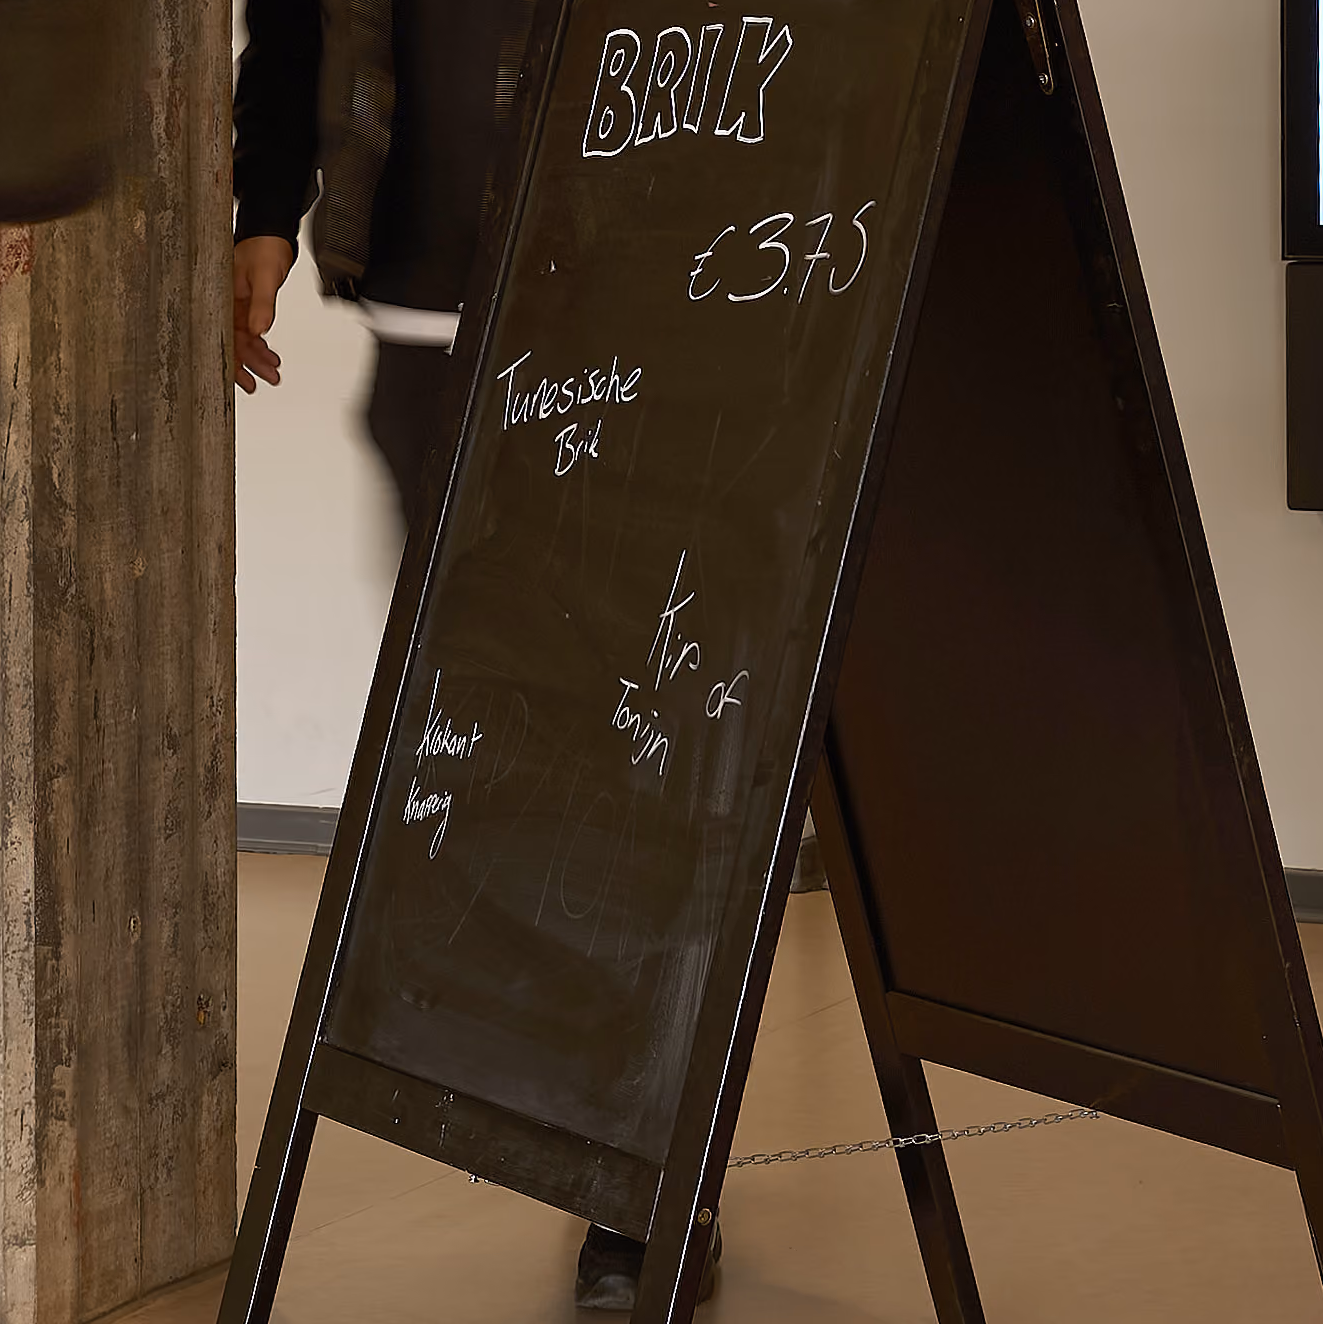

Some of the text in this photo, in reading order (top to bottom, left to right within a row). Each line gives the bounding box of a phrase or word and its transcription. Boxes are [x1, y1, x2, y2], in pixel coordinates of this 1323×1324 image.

[581, 15, 794, 159] BRIK
[553, 417, 603, 478] Brik
[645, 548, 701, 692] Kip
